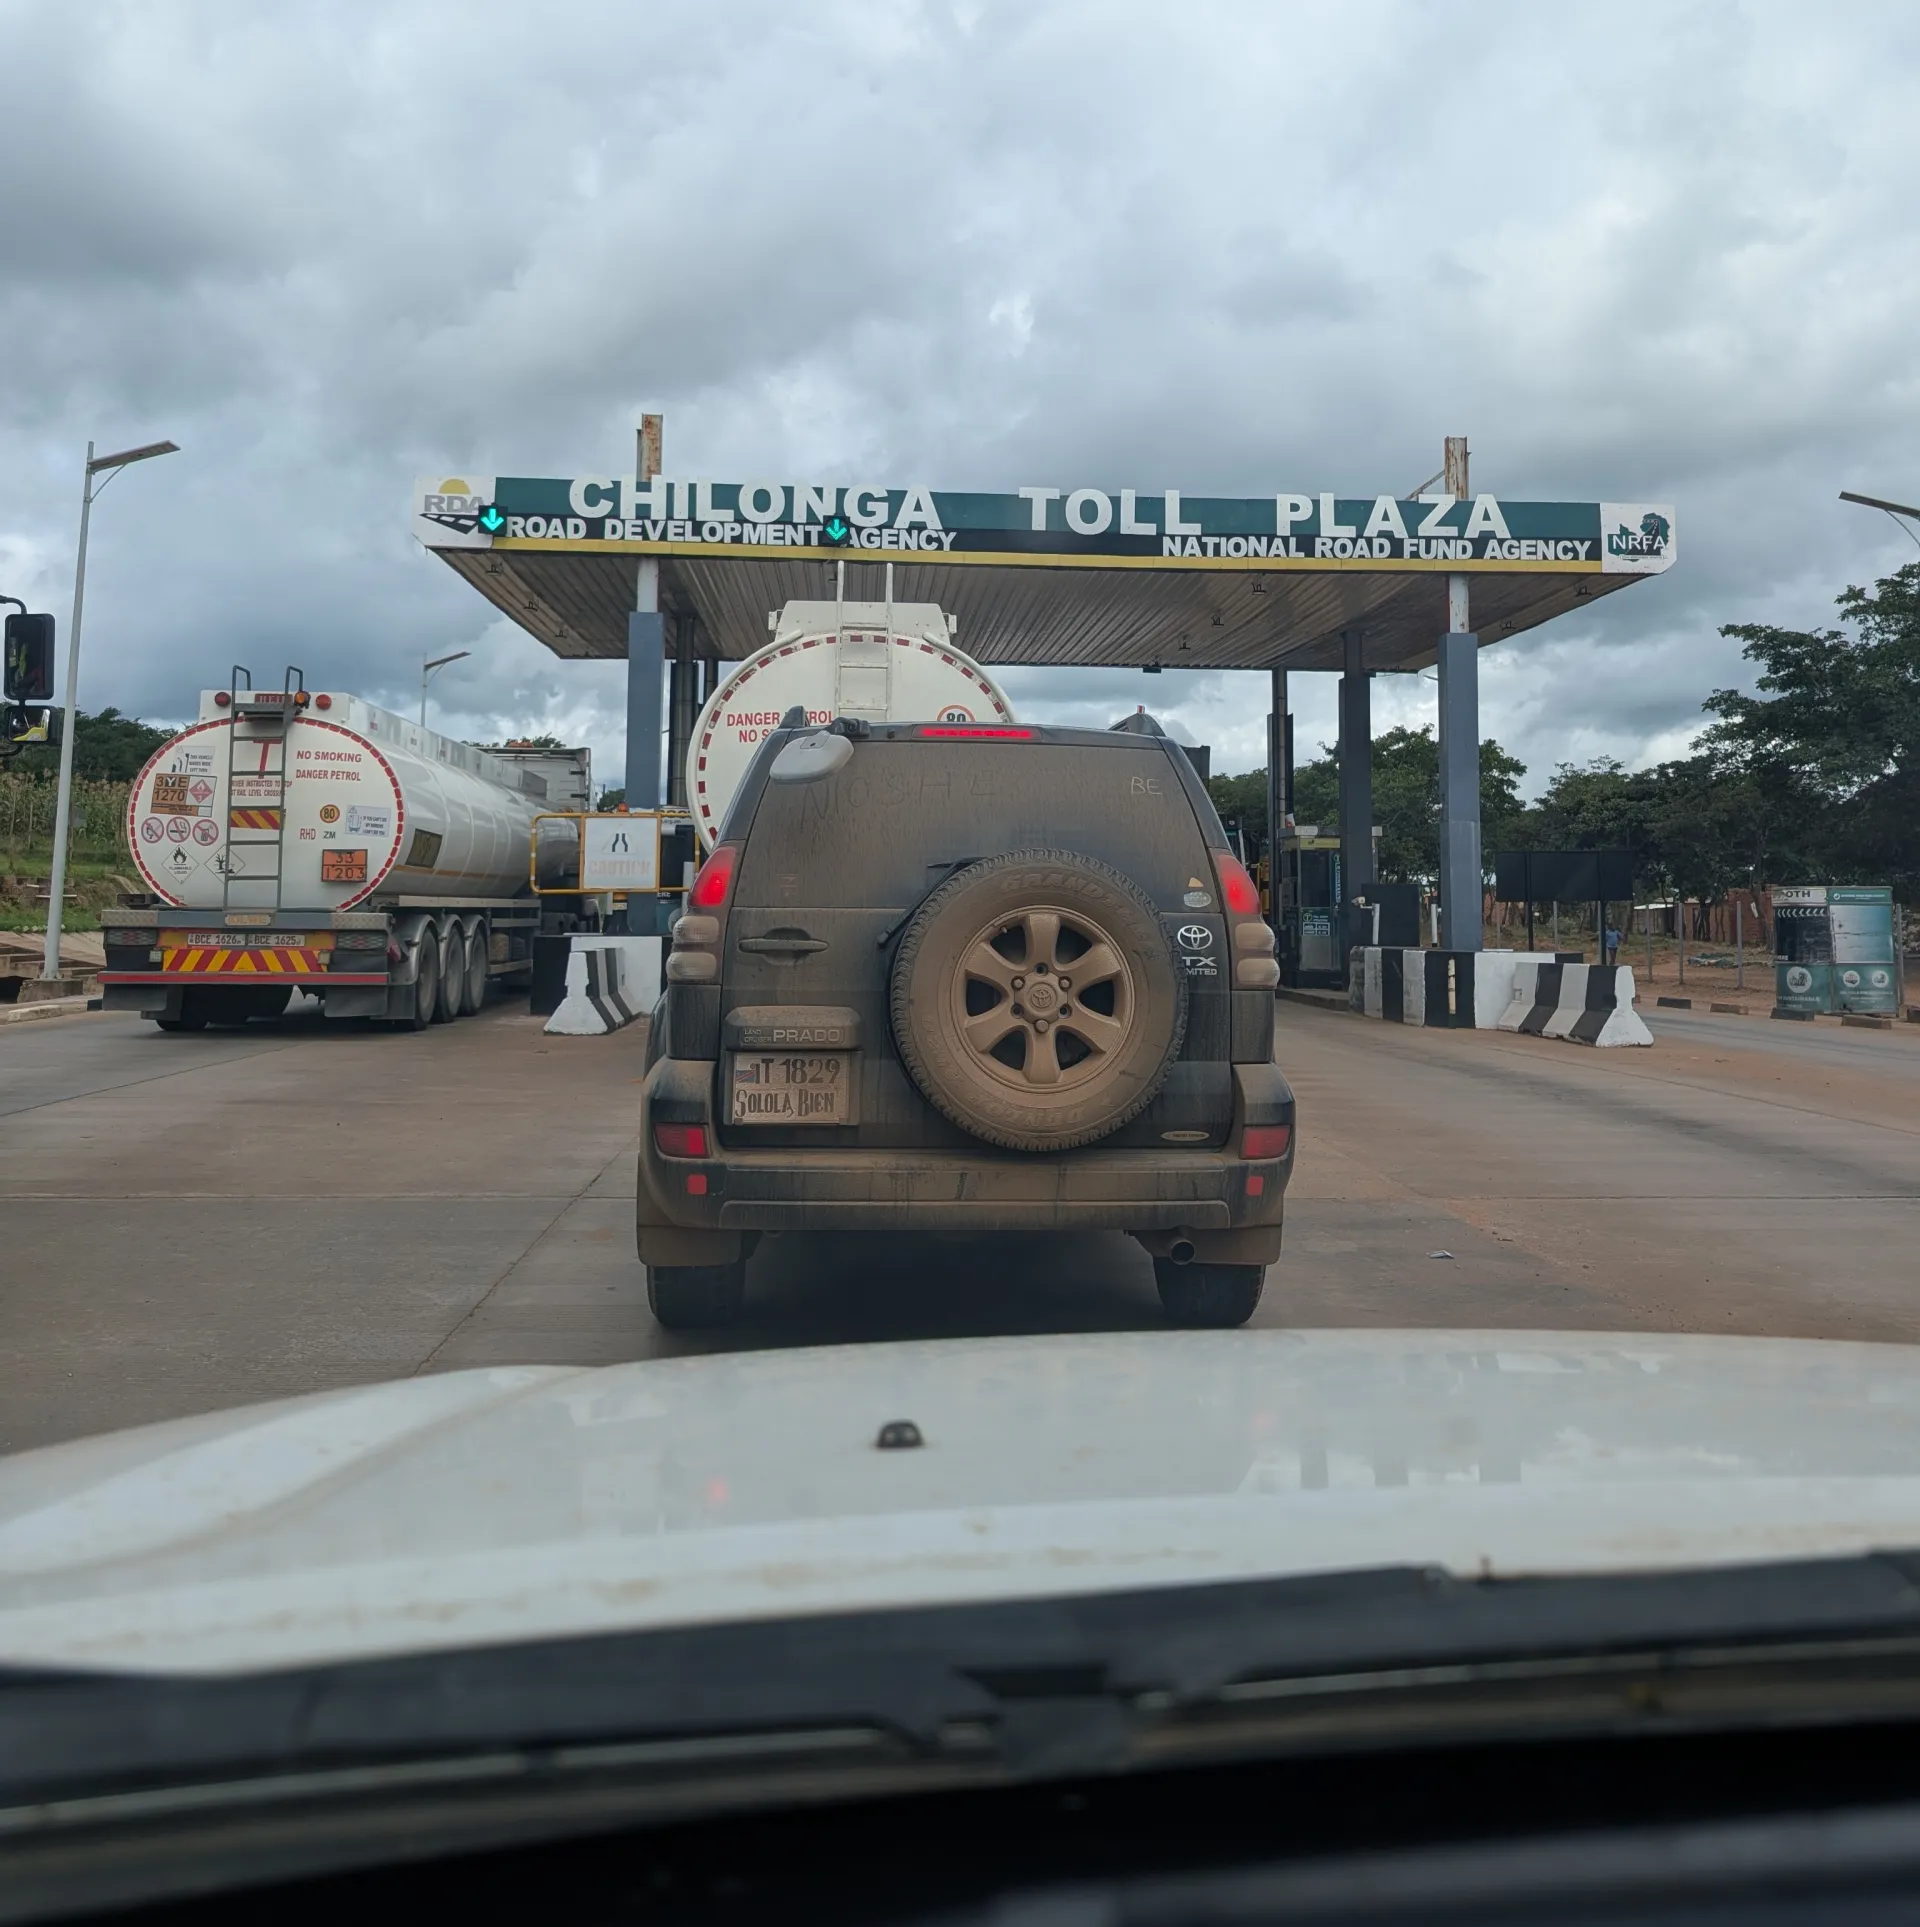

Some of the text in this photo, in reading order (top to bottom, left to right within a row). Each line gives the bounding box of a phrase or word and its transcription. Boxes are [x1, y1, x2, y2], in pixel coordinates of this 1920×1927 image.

[424, 494, 485, 513] RDA
[570, 475, 1512, 539] CHILONGA TOLL PLAZA
[507, 516, 957, 551] ROAD DEVELOPMENT AGENCY
[1612, 534, 1667, 550] NRFA
[1163, 535, 1591, 562] NATIONAL ROAD FUND AGENCY
[726, 711, 780, 727] DANGER
[738, 729, 758, 743] NO
[296, 750, 362, 763] NO SMOKING
[296, 769, 361, 781] DANGER PETROL
[154, 790, 185, 801] 1270
[323, 808, 335, 819] 80
[300, 828, 316, 840] RHD
[327, 867, 365, 879] 1203
[1785, 890, 1811, 898] OTH
[195, 934, 211, 944] BCE
[215, 935, 237, 944] 1626
[254, 935, 297, 945] BCE 1625
[1181, 956, 1218, 967] TX
[1186, 967, 1218, 976] MITED
[773, 1029, 841, 1042] PRADO
[779, 1058, 841, 1084] 1829
